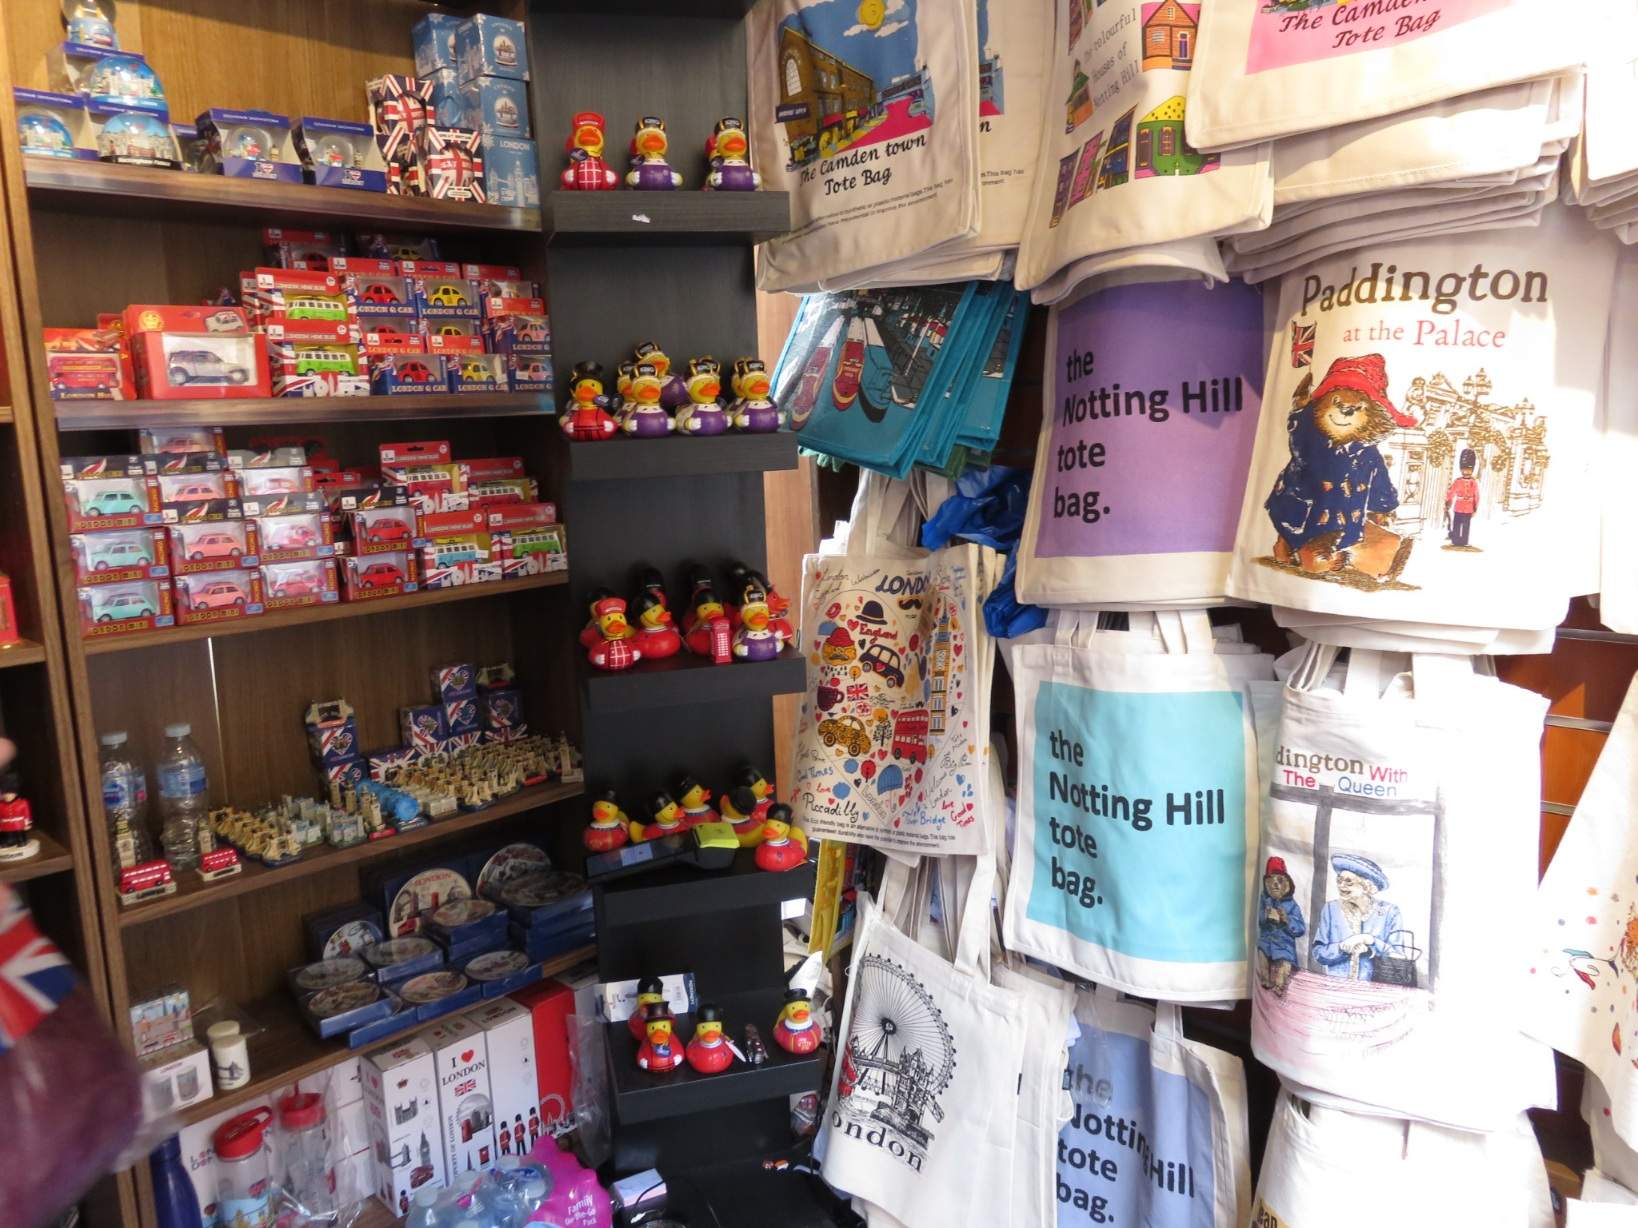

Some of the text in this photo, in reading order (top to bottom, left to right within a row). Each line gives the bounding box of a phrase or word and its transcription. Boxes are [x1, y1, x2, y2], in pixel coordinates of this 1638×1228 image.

[1279, 13, 1322, 33] The
[1332, 9, 1441, 49] Tote Bag
[800, 134, 926, 186] The Camden town
[824, 167, 892, 196] Tote Bag
[1301, 263, 1549, 315] Paddington
[1343, 320, 1505, 348] at the Palace
[1066, 349, 1094, 384] the
[1062, 377, 1243, 427] Notting Hill
[1057, 440, 1107, 473] tote
[1053, 486, 1112, 524] bag.
[859, 622, 898, 645] England
[1049, 729, 1084, 768] the
[1283, 769, 1398, 798] The Queen
[1369, 764, 1409, 785] With
[1049, 771, 1225, 831] Notting Hill
[920, 811, 946, 830] Bridge
[1049, 816, 1099, 859] tote
[1051, 856, 1104, 910] bag.
[441, 1060, 487, 1087] LONDON
[450, 1057, 457, 1068] I
[832, 1110, 923, 1174] ondon
[1057, 1138, 1118, 1183] tote
[1057, 1172, 1115, 1224] bag.
[1149, 1159, 1195, 1199] Hill
